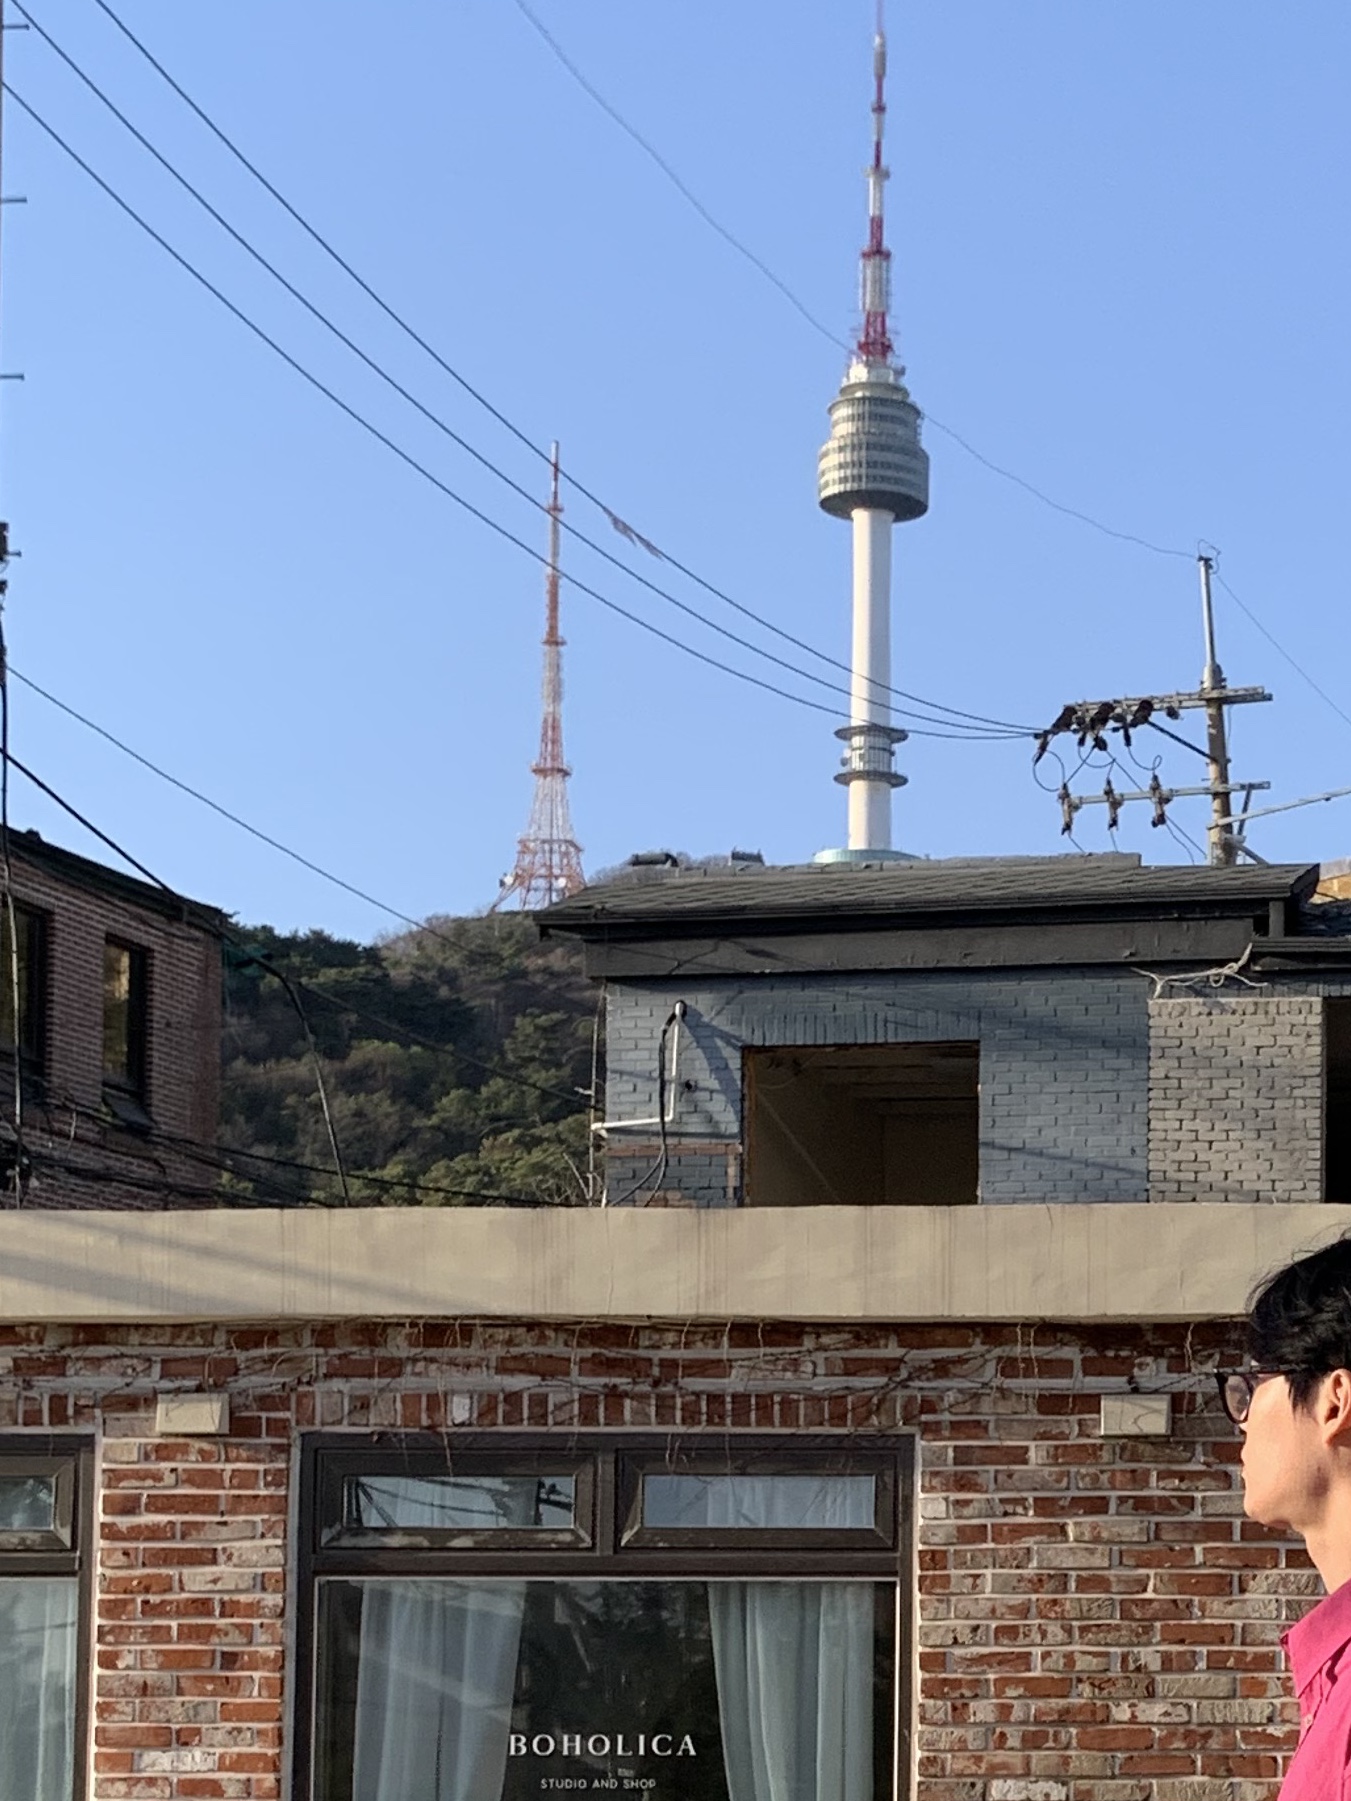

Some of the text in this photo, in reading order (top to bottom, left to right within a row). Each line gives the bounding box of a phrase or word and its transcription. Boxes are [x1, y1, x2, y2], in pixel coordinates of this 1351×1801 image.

[508, 1733, 697, 1756] BOHOLICA
[540, 1778, 656, 1789] STUDIO AND SHOP
